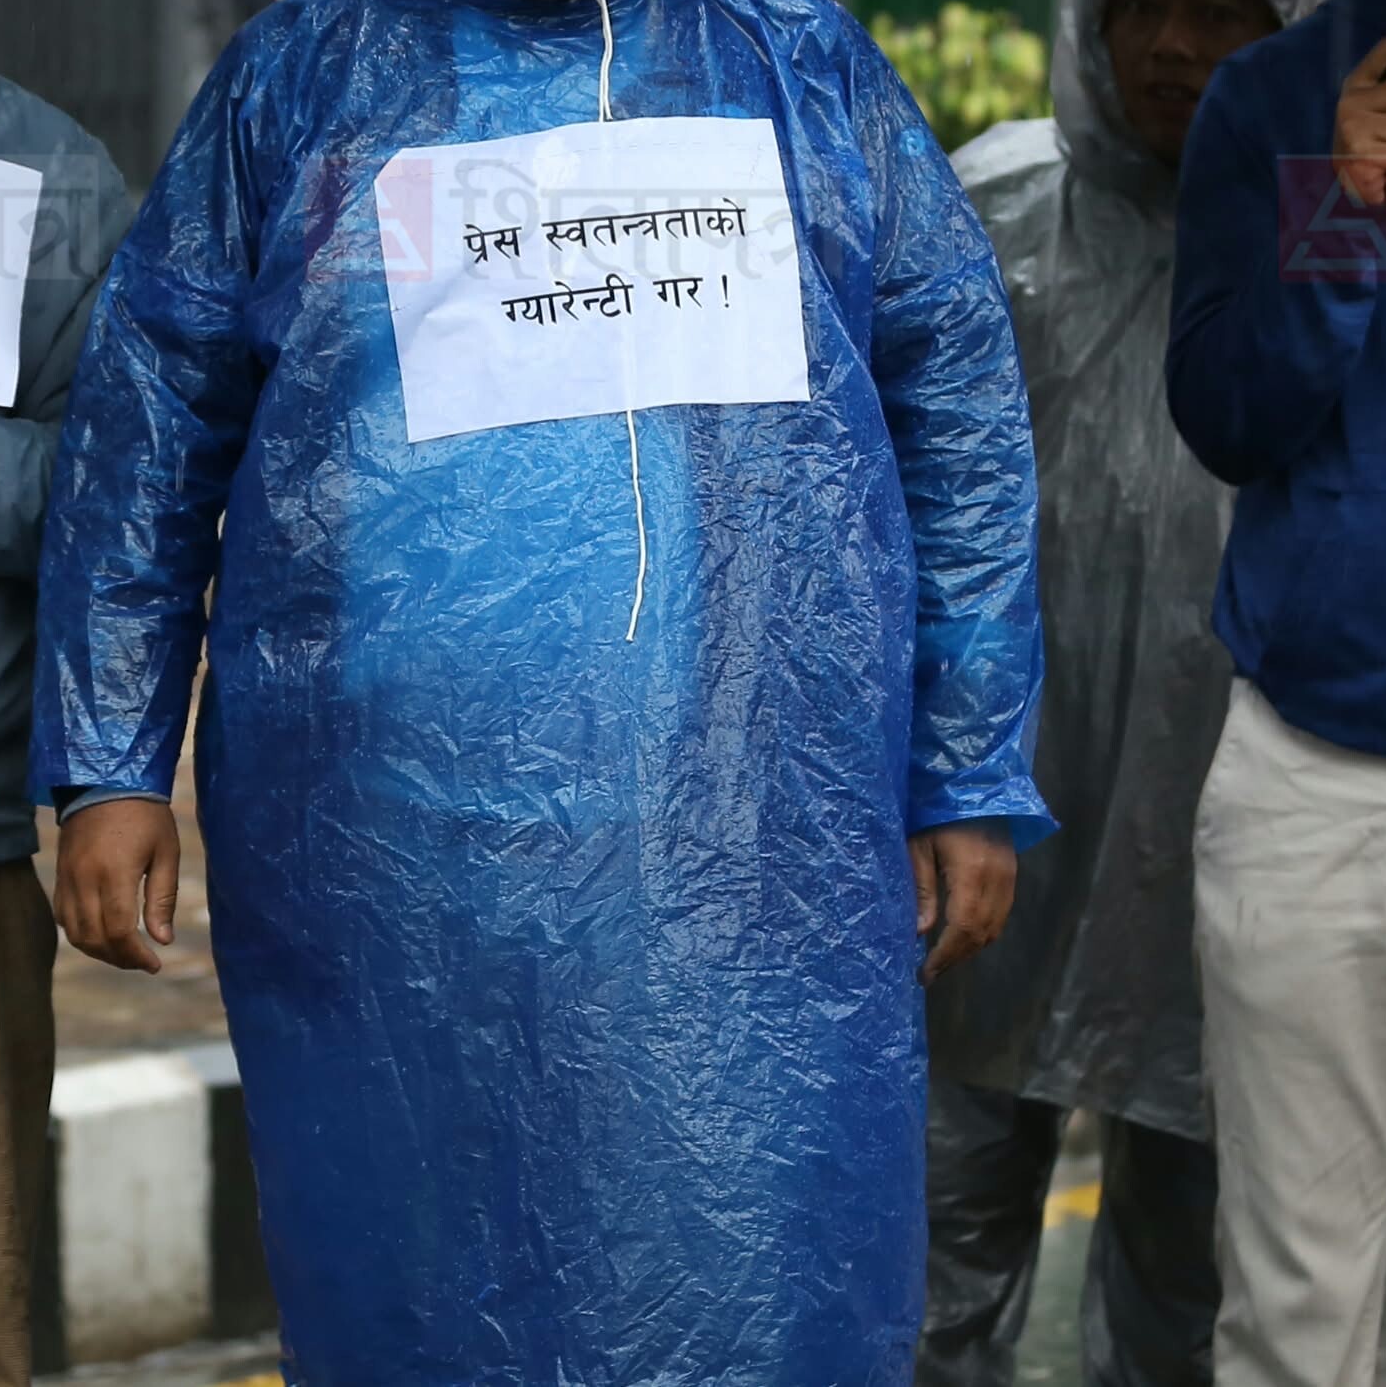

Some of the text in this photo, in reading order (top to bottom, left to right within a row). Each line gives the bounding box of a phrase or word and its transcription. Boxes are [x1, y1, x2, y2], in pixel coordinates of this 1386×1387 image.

[463, 197, 747, 265] प्रेस स्वतन्त्रताको
[501, 273, 634, 327] ग्यारेन्टी
[653, 276, 704, 309] गर
